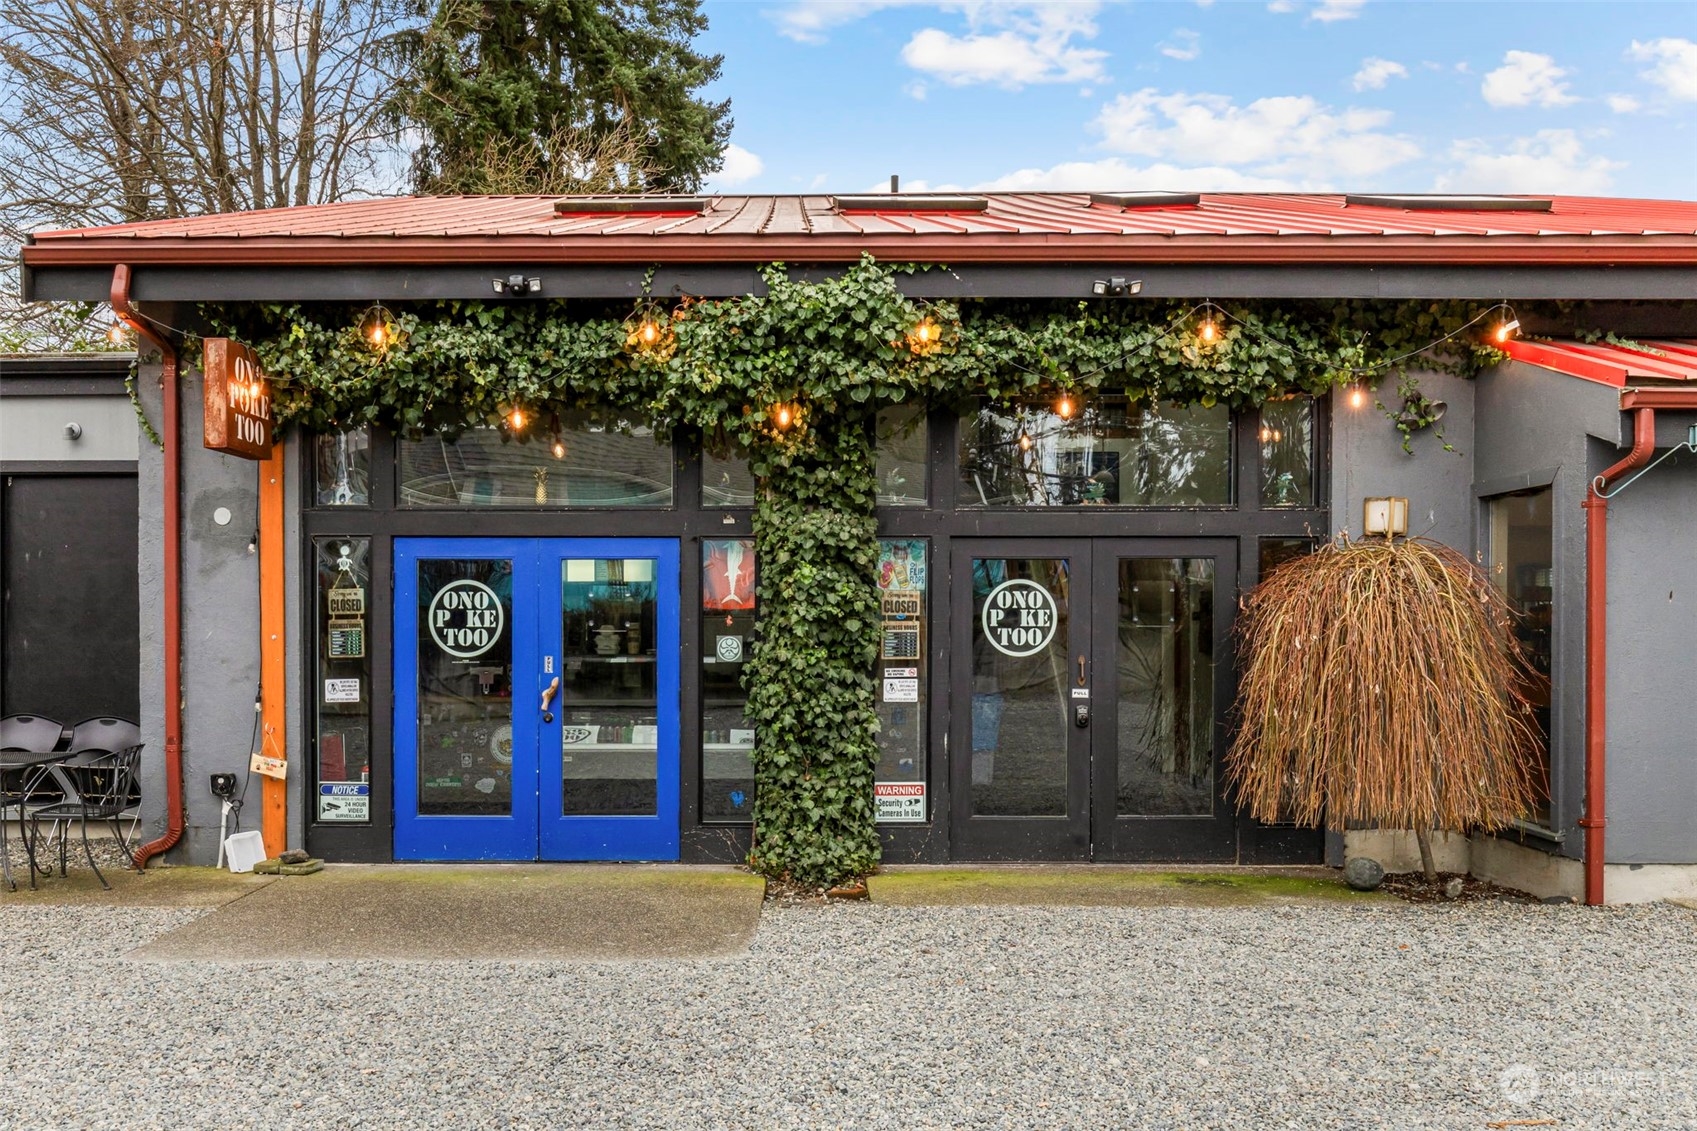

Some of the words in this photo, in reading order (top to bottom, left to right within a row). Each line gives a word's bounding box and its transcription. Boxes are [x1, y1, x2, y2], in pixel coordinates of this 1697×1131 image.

[234, 413, 265, 446] TOO
[330, 598, 362, 613] CLOSED
[443, 591, 489, 610] ONO
[883, 600, 918, 613] CLOSED
[996, 590, 1043, 609] ONO
[443, 628, 489, 647] TOO
[997, 627, 1043, 646] TOO
[331, 785, 360, 795] NOTICE
[877, 786, 922, 795] WARNING
[878, 798, 903, 808] Security
[878, 809, 903, 818] Cameras
[903, 809, 910, 817] In
[911, 809, 922, 817] Use
